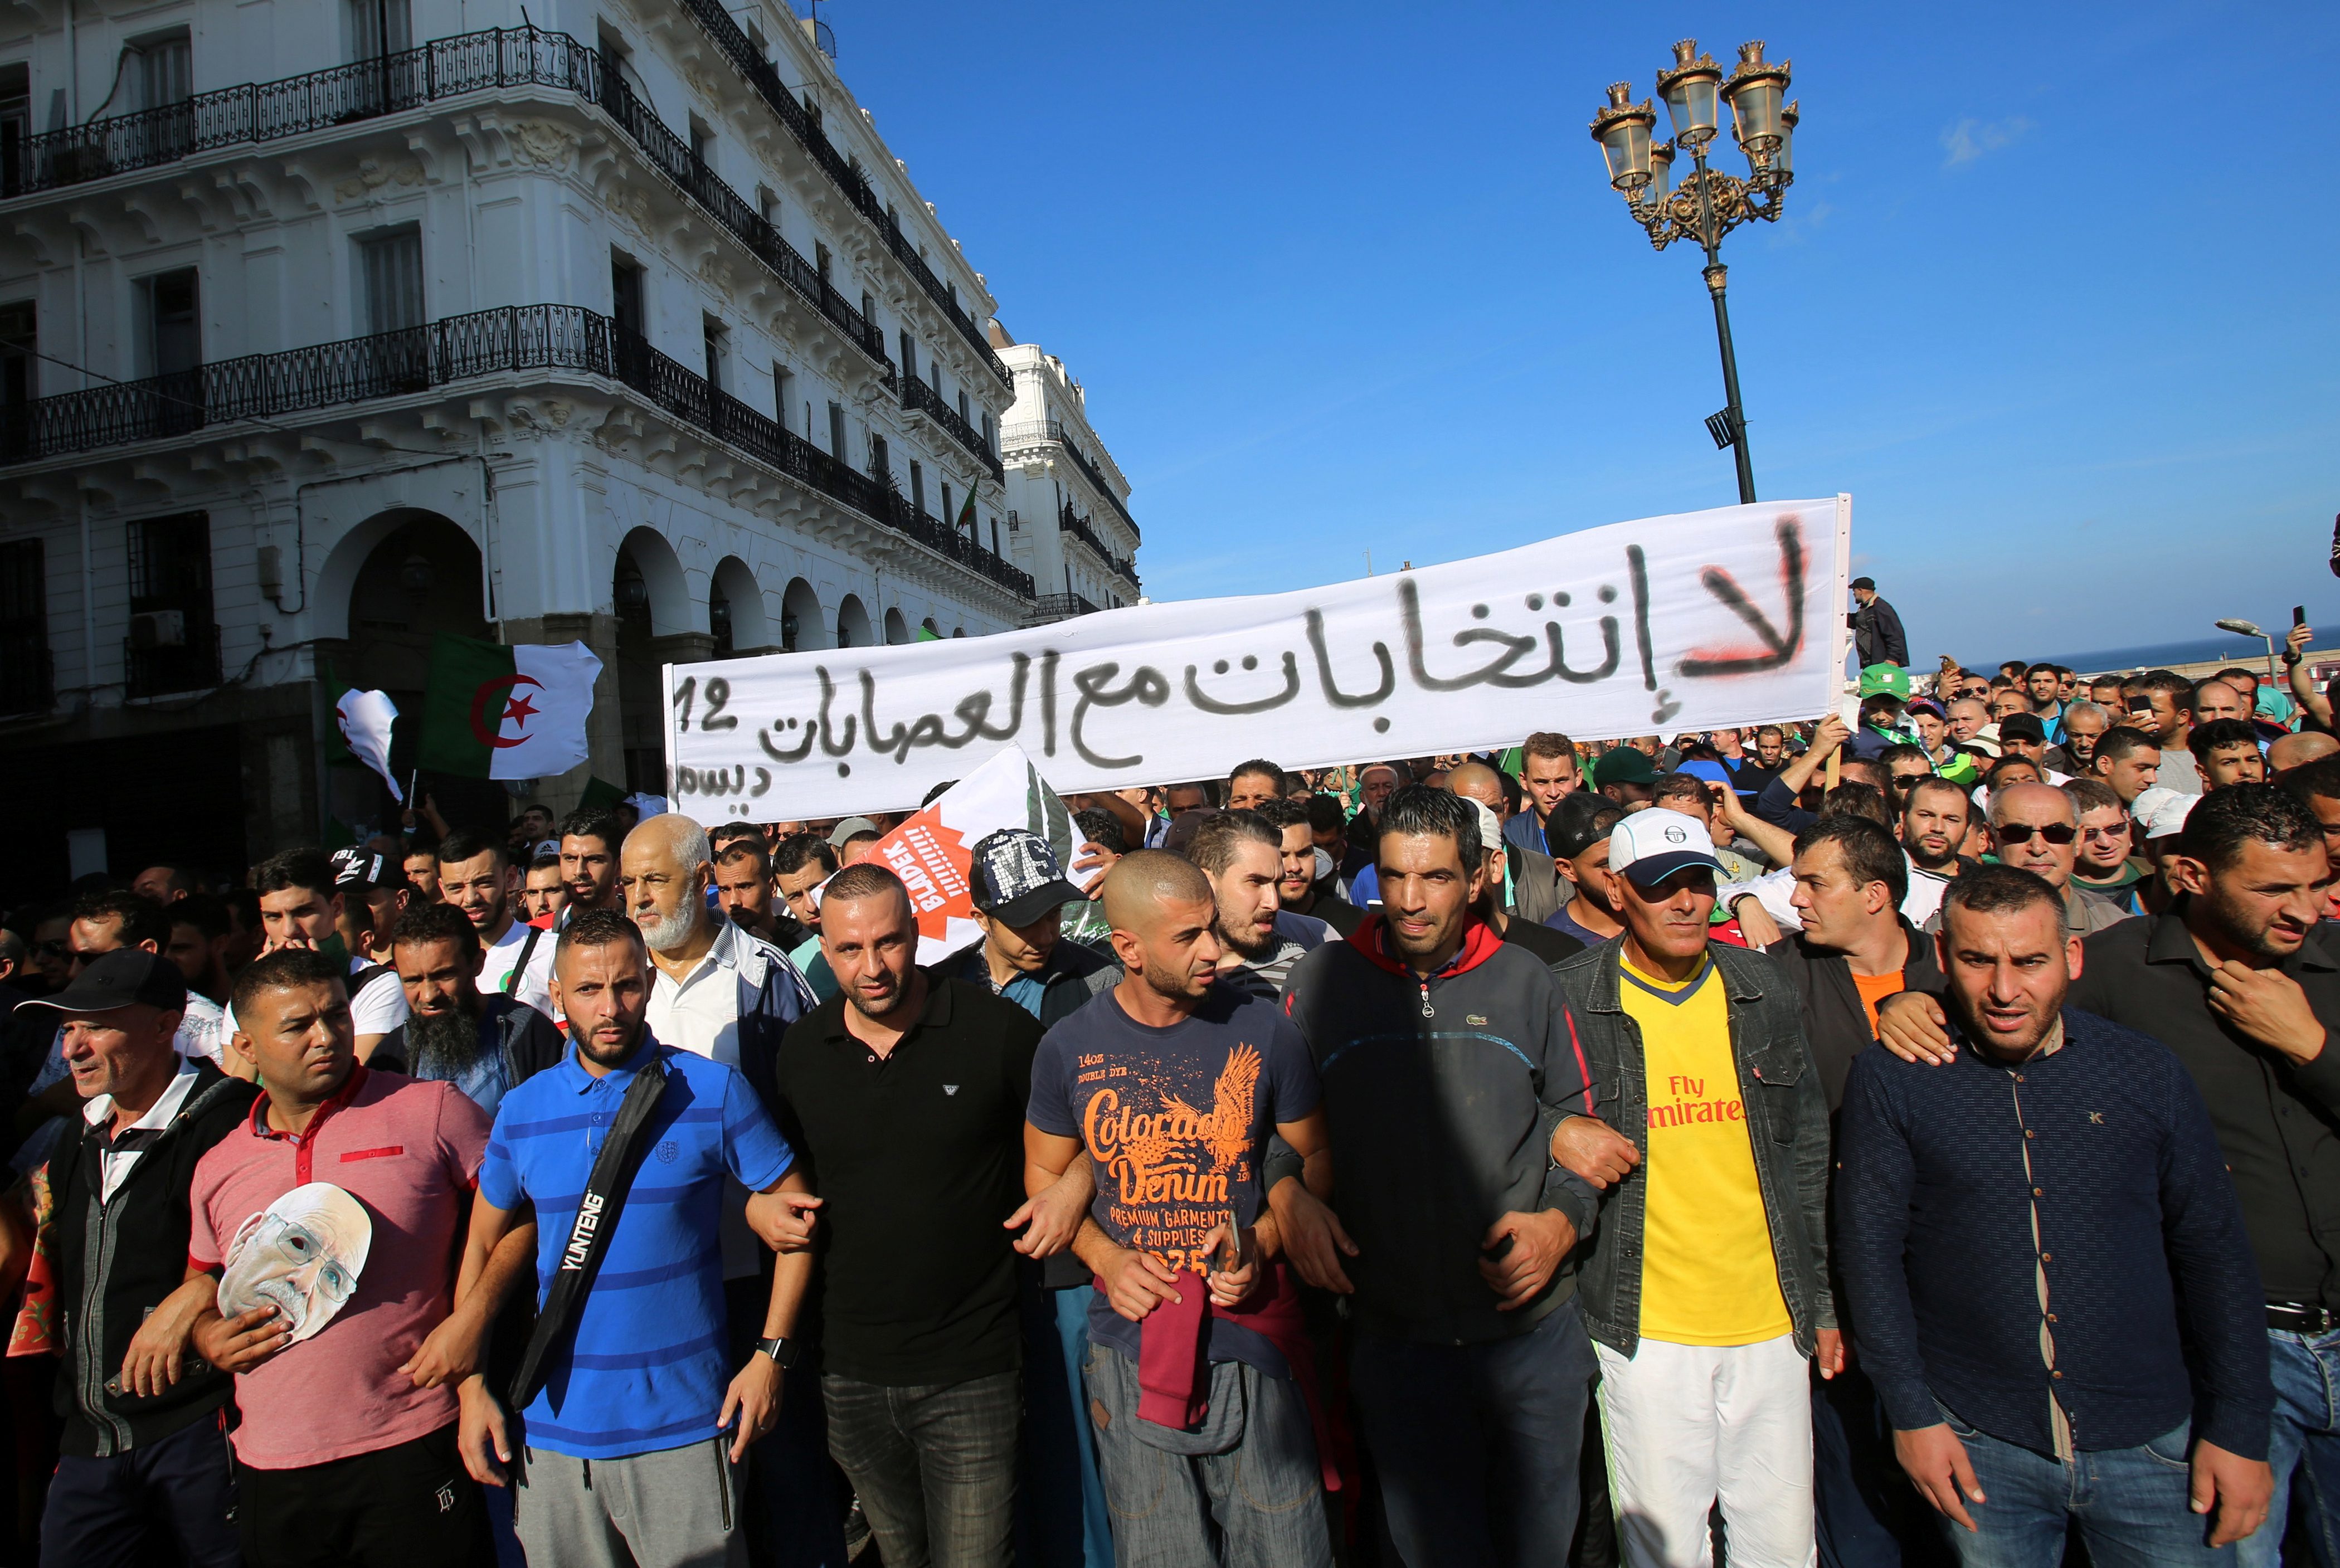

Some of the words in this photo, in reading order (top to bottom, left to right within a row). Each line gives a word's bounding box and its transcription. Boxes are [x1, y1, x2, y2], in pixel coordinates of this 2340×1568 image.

[1677, 514, 1806, 679] لا
[674, 676, 738, 732] 12
[758, 650, 1061, 778] العصابات
[1071, 663, 1170, 769] مع
[330, 849, 356, 863] FBI
[883, 840, 946, 913] BLADEK
[1108, 1067, 1127, 1077] DYE
[1668, 1075, 1704, 1098] Fly
[1084, 1088, 1243, 1162] Colorado
[1647, 1097, 1747, 1128] mirate
[1108, 1154, 1228, 1206] Denim
[562, 1192, 604, 1270] YUNTENG
[1110, 1206, 1160, 1228] PREMIUM
[1133, 1227, 1142, 1245] &
[1147, 1228, 1207, 1247] SUPPLIES
[1137, 1249, 1207, 1277] 76
